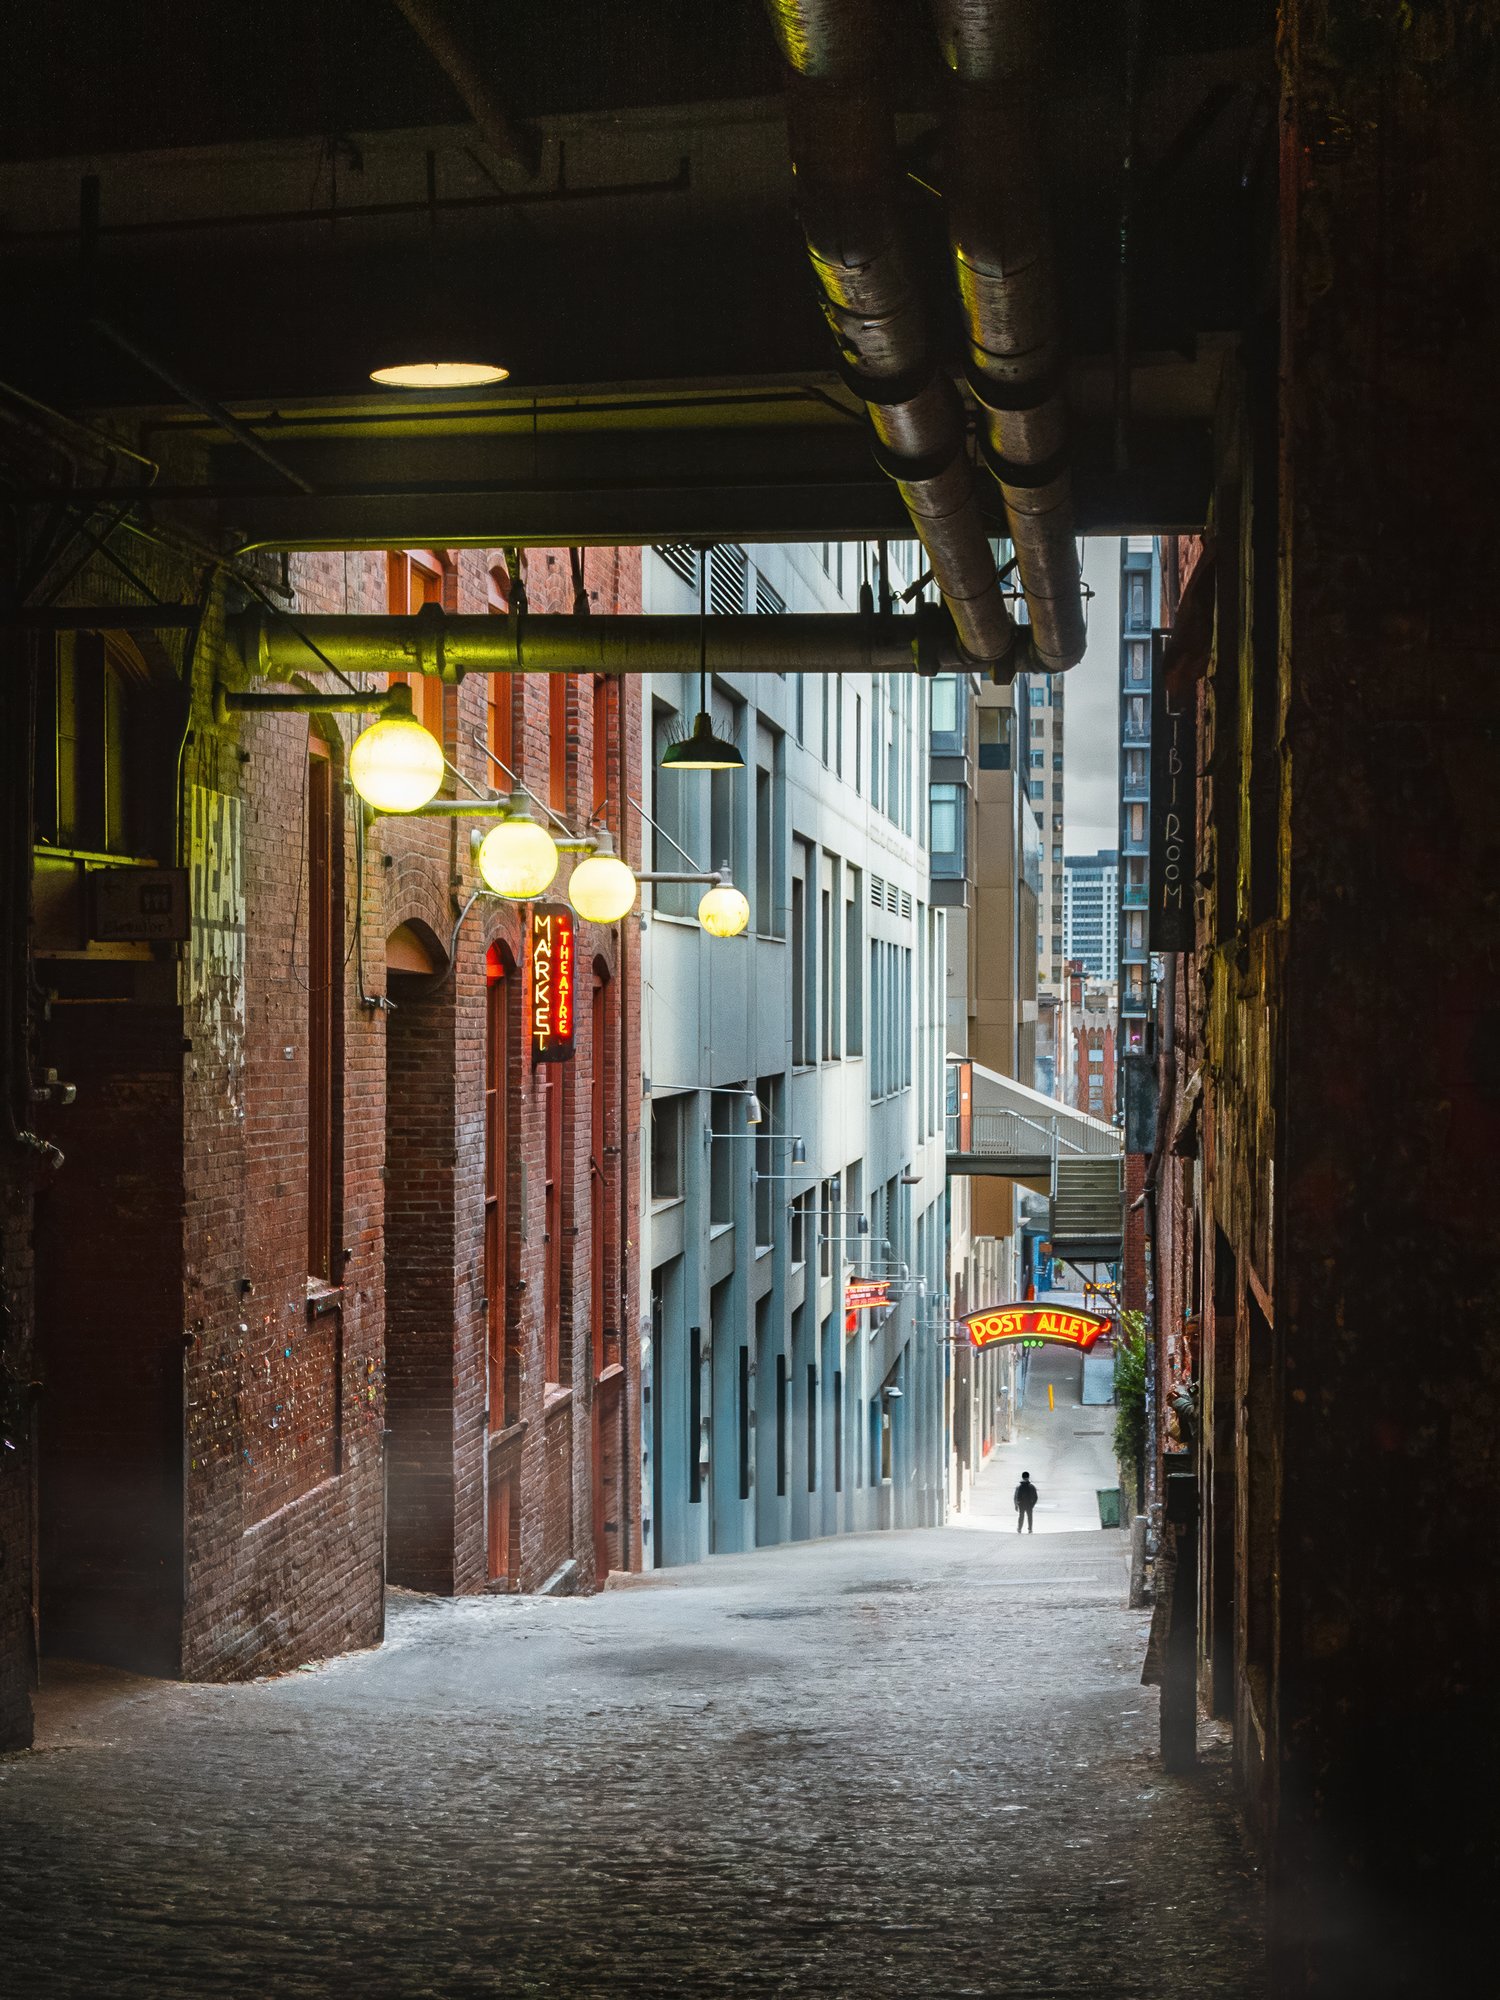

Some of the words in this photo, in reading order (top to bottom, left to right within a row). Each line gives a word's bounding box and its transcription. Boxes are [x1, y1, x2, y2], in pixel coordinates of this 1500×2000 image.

[1163, 812, 1184, 911] ROOM
[533, 914, 552, 1051] MARKET
[558, 931, 570, 1034] THEATRE
[970, 1314, 1024, 1346] POST
[1036, 1314, 1100, 1346] ALLEY
